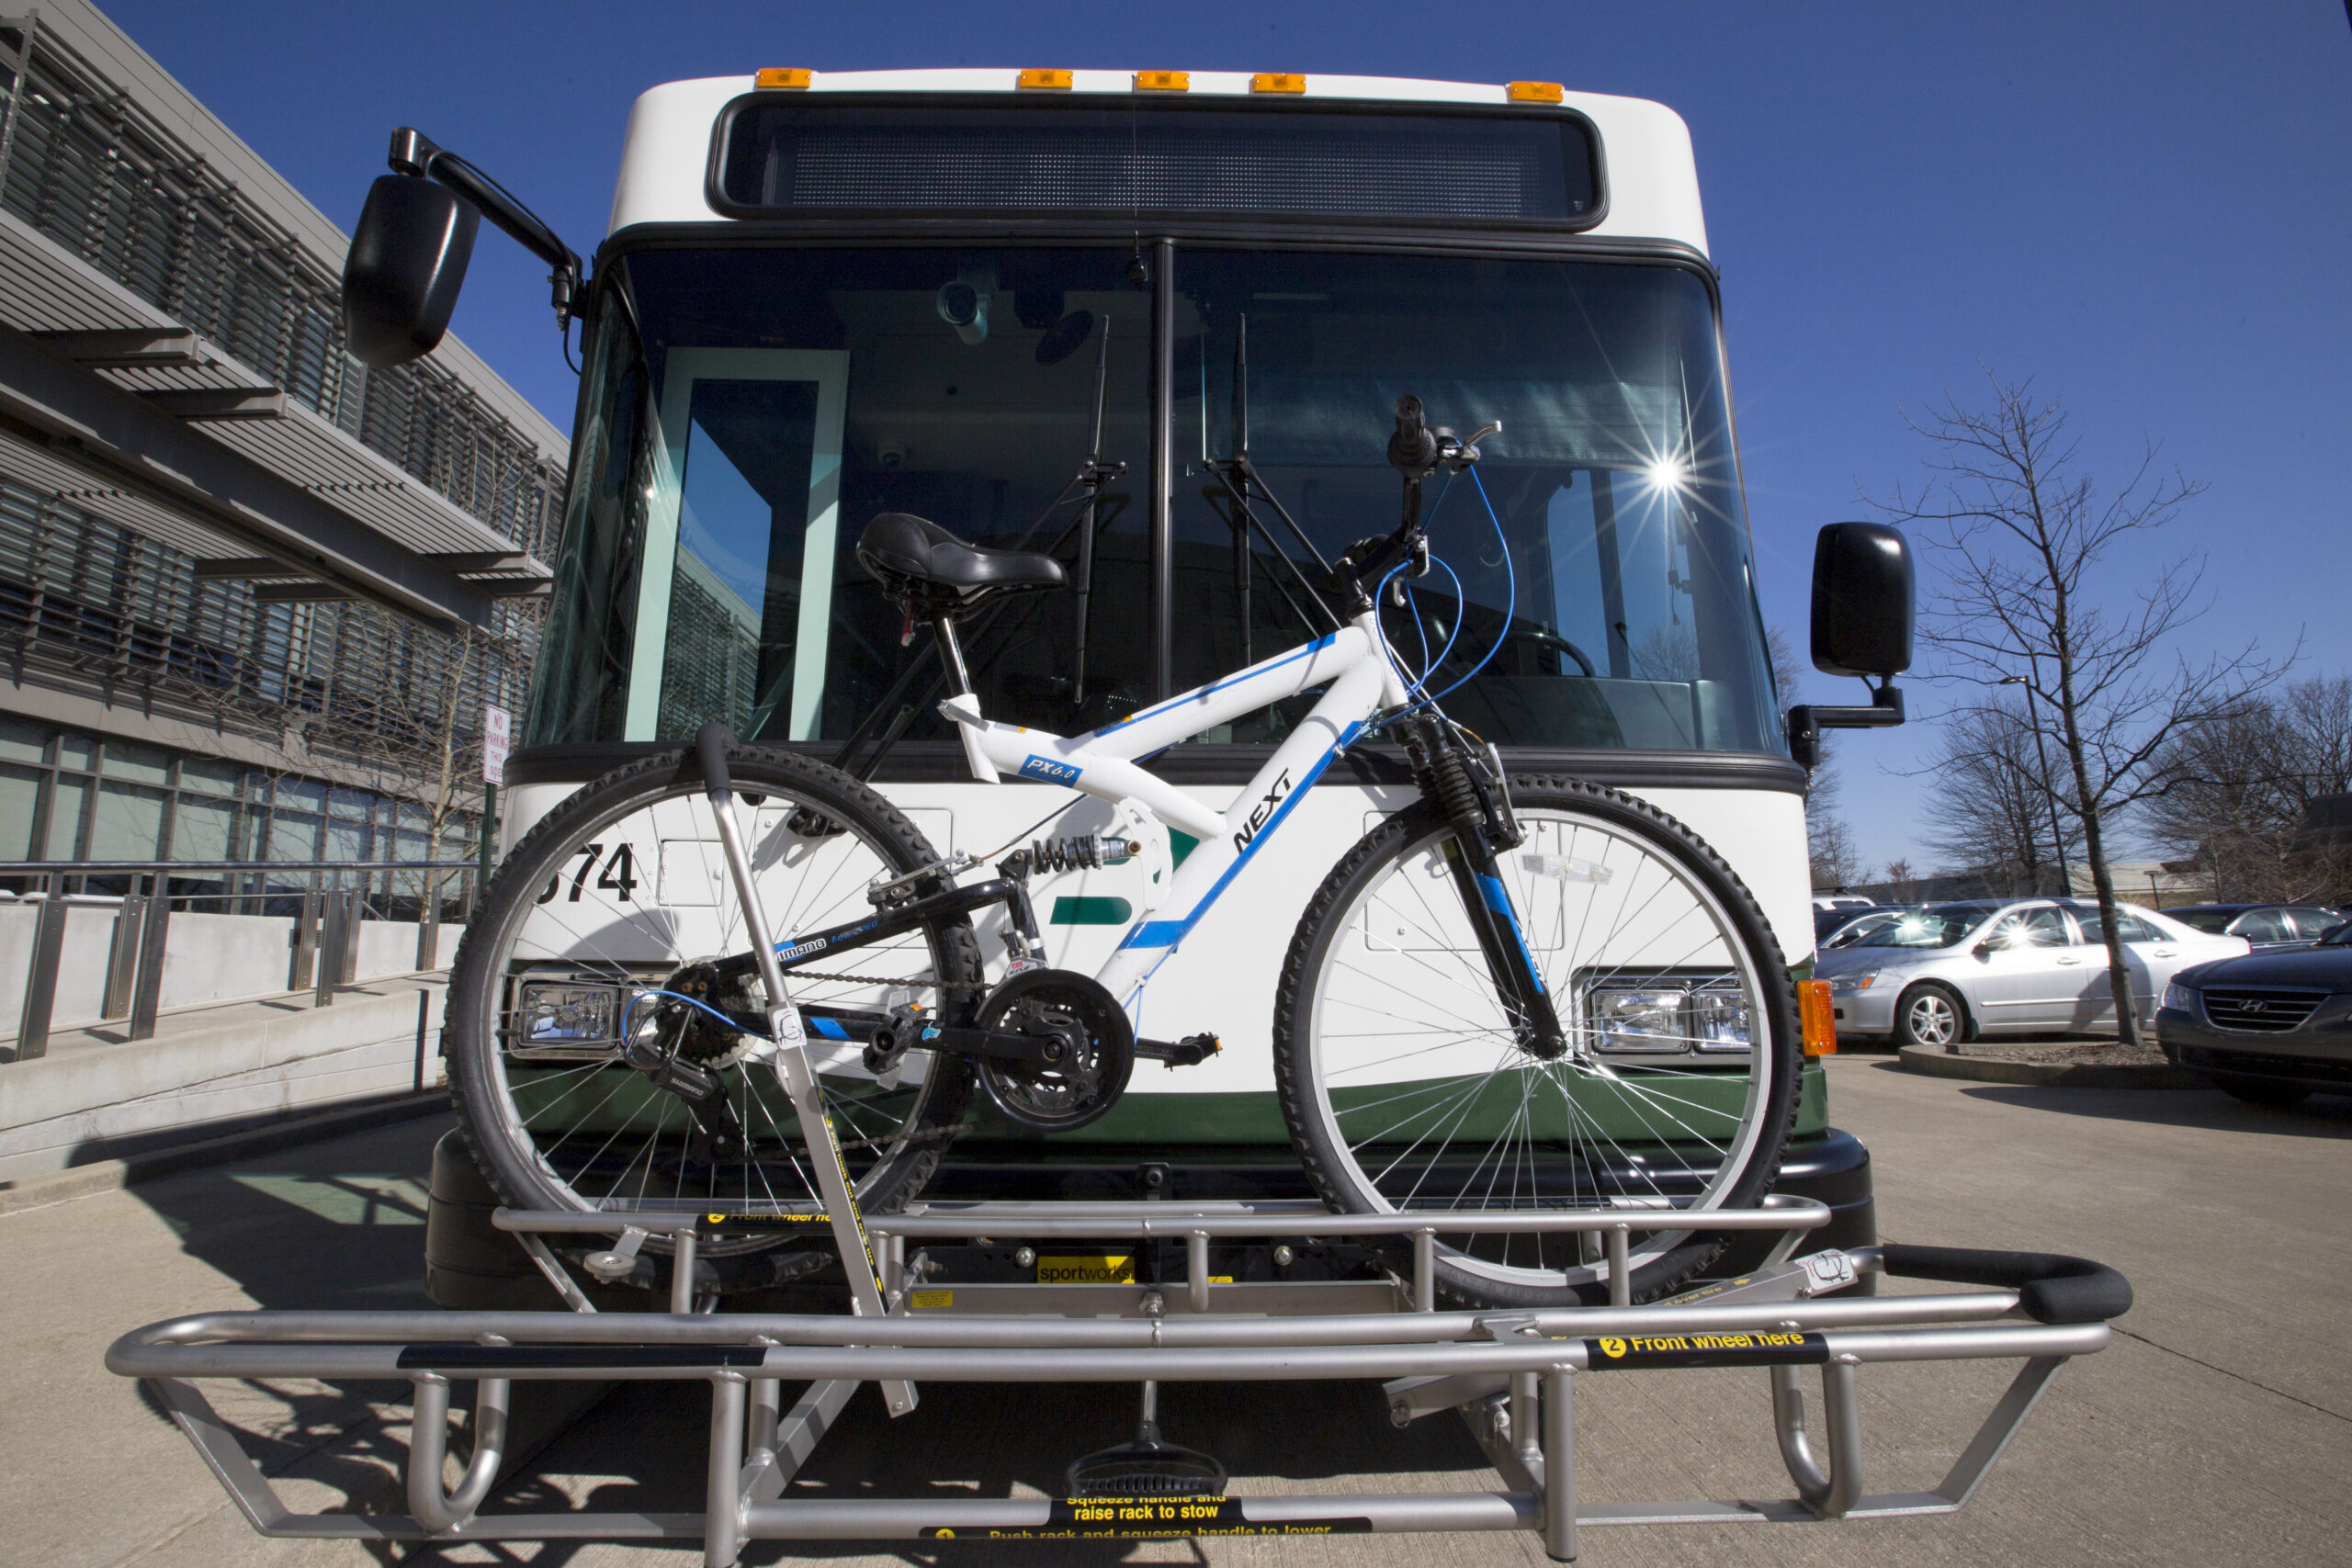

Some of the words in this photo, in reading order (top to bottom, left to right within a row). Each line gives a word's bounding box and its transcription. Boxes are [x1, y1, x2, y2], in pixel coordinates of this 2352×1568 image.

[493, 714, 503, 729] NO
[487, 731, 508, 750] PARKING
[491, 750, 503, 763] THIS
[490, 766, 502, 777] SIDE
[1026, 759, 1076, 779] PX6.0
[1233, 766, 1291, 855] NEXT
[537, 842, 638, 905] 74
[775, 938, 827, 962] IMANO
[831, 1132, 840, 1151] Pull
[837, 1154, 848, 1179] hook
[845, 1181, 854, 1199] out
[852, 1201, 861, 1221] and
[858, 1223, 868, 1246] over
[866, 1247, 875, 1267] tire
[1040, 1265, 1130, 1283] sportworks
[1675, 1293, 1700, 1304] over
[1702, 1287, 1723, 1296] tire
[1631, 1337, 1690, 1351] Front
[1691, 1334, 1753, 1349] wheel
[1758, 1333, 1804, 1347] here
[1067, 1497, 1133, 1506] Squeeze
[1074, 1506, 1114, 1520] raise
[1119, 1506, 1153, 1519] rack
[1159, 1506, 1175, 1518] to
[1181, 1505, 1218, 1518] stow
[989, 1530, 1033, 1539] Push
[1040, 1529, 1076, 1539] rack
[1083, 1529, 1114, 1539] and
[1121, 1529, 1192, 1538] squeeze
[1198, 1527, 1255, 1537] handle
[1261, 1526, 1278, 1535] to
[1284, 1525, 1331, 1535] lower
